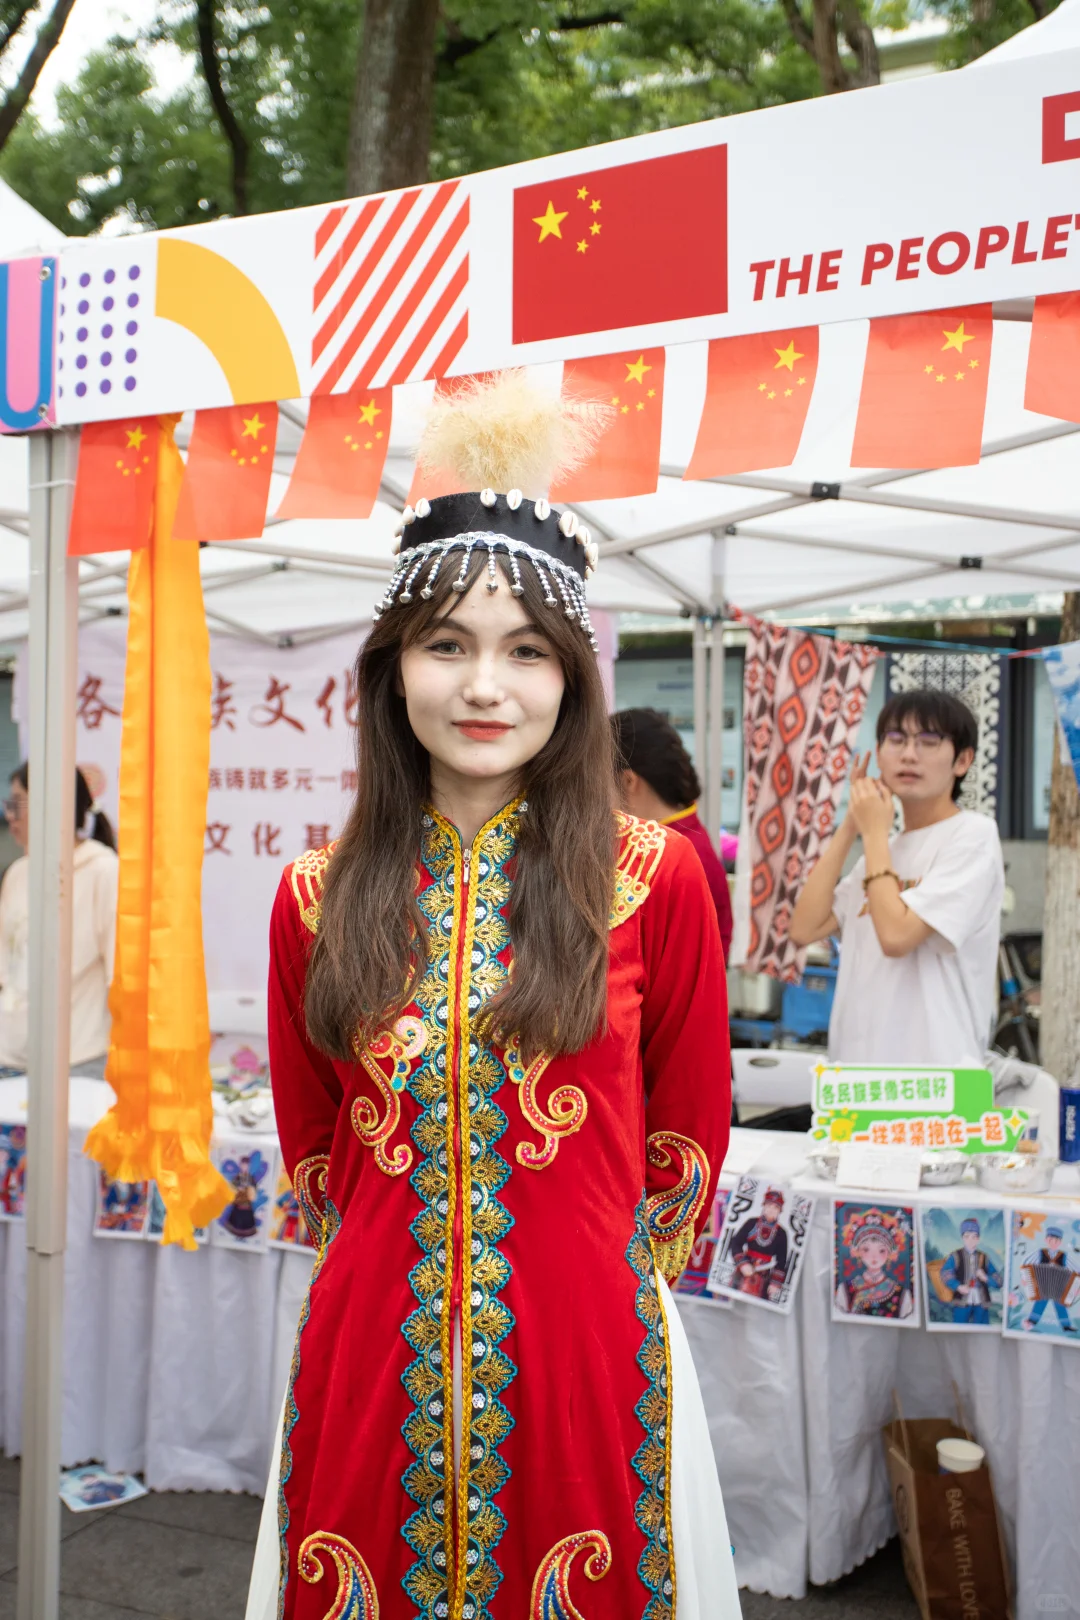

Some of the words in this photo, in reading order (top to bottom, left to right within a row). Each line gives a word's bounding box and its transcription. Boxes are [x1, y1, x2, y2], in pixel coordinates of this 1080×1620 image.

[750, 249, 843, 301] THE
[945, 1487, 967, 1530] BAKE
[953, 1534, 975, 1578] WITH
